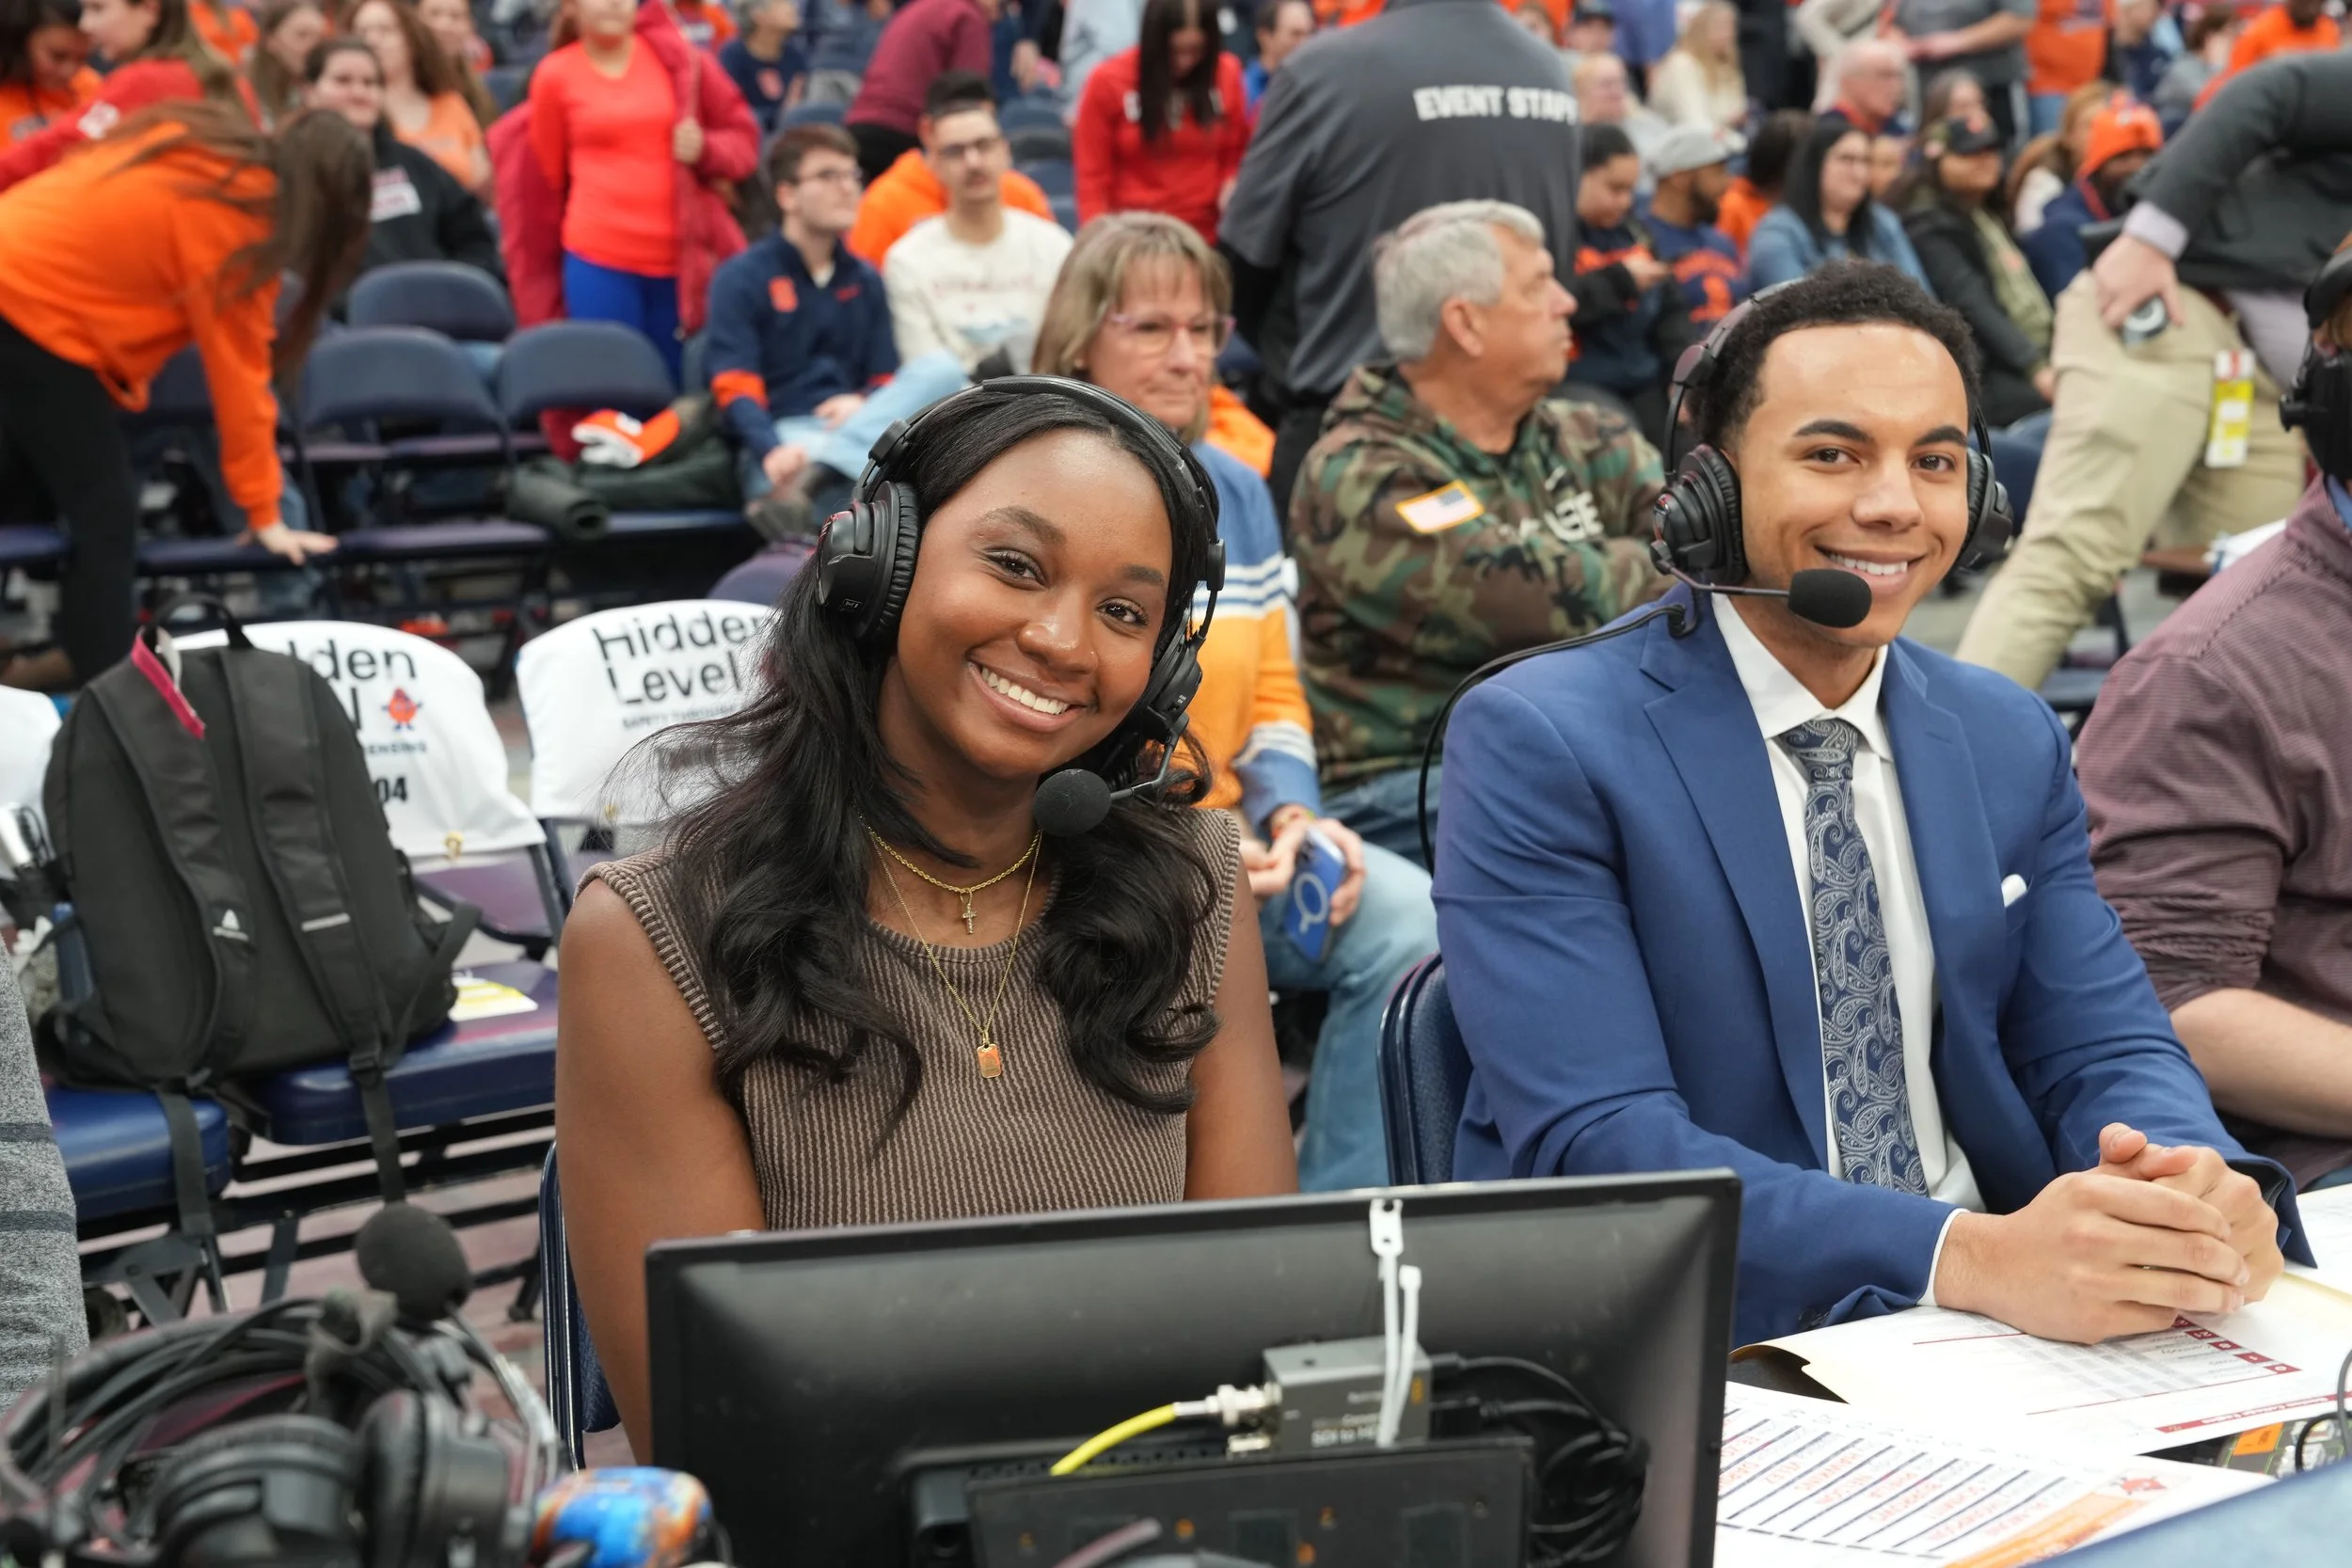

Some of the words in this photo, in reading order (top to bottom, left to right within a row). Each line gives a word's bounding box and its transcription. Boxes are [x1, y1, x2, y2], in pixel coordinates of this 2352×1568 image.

[1414, 86, 1503, 119] EVENT
[288, 639, 416, 681] den
[607, 651, 743, 705] Level
[368, 738, 427, 754] ENSING
